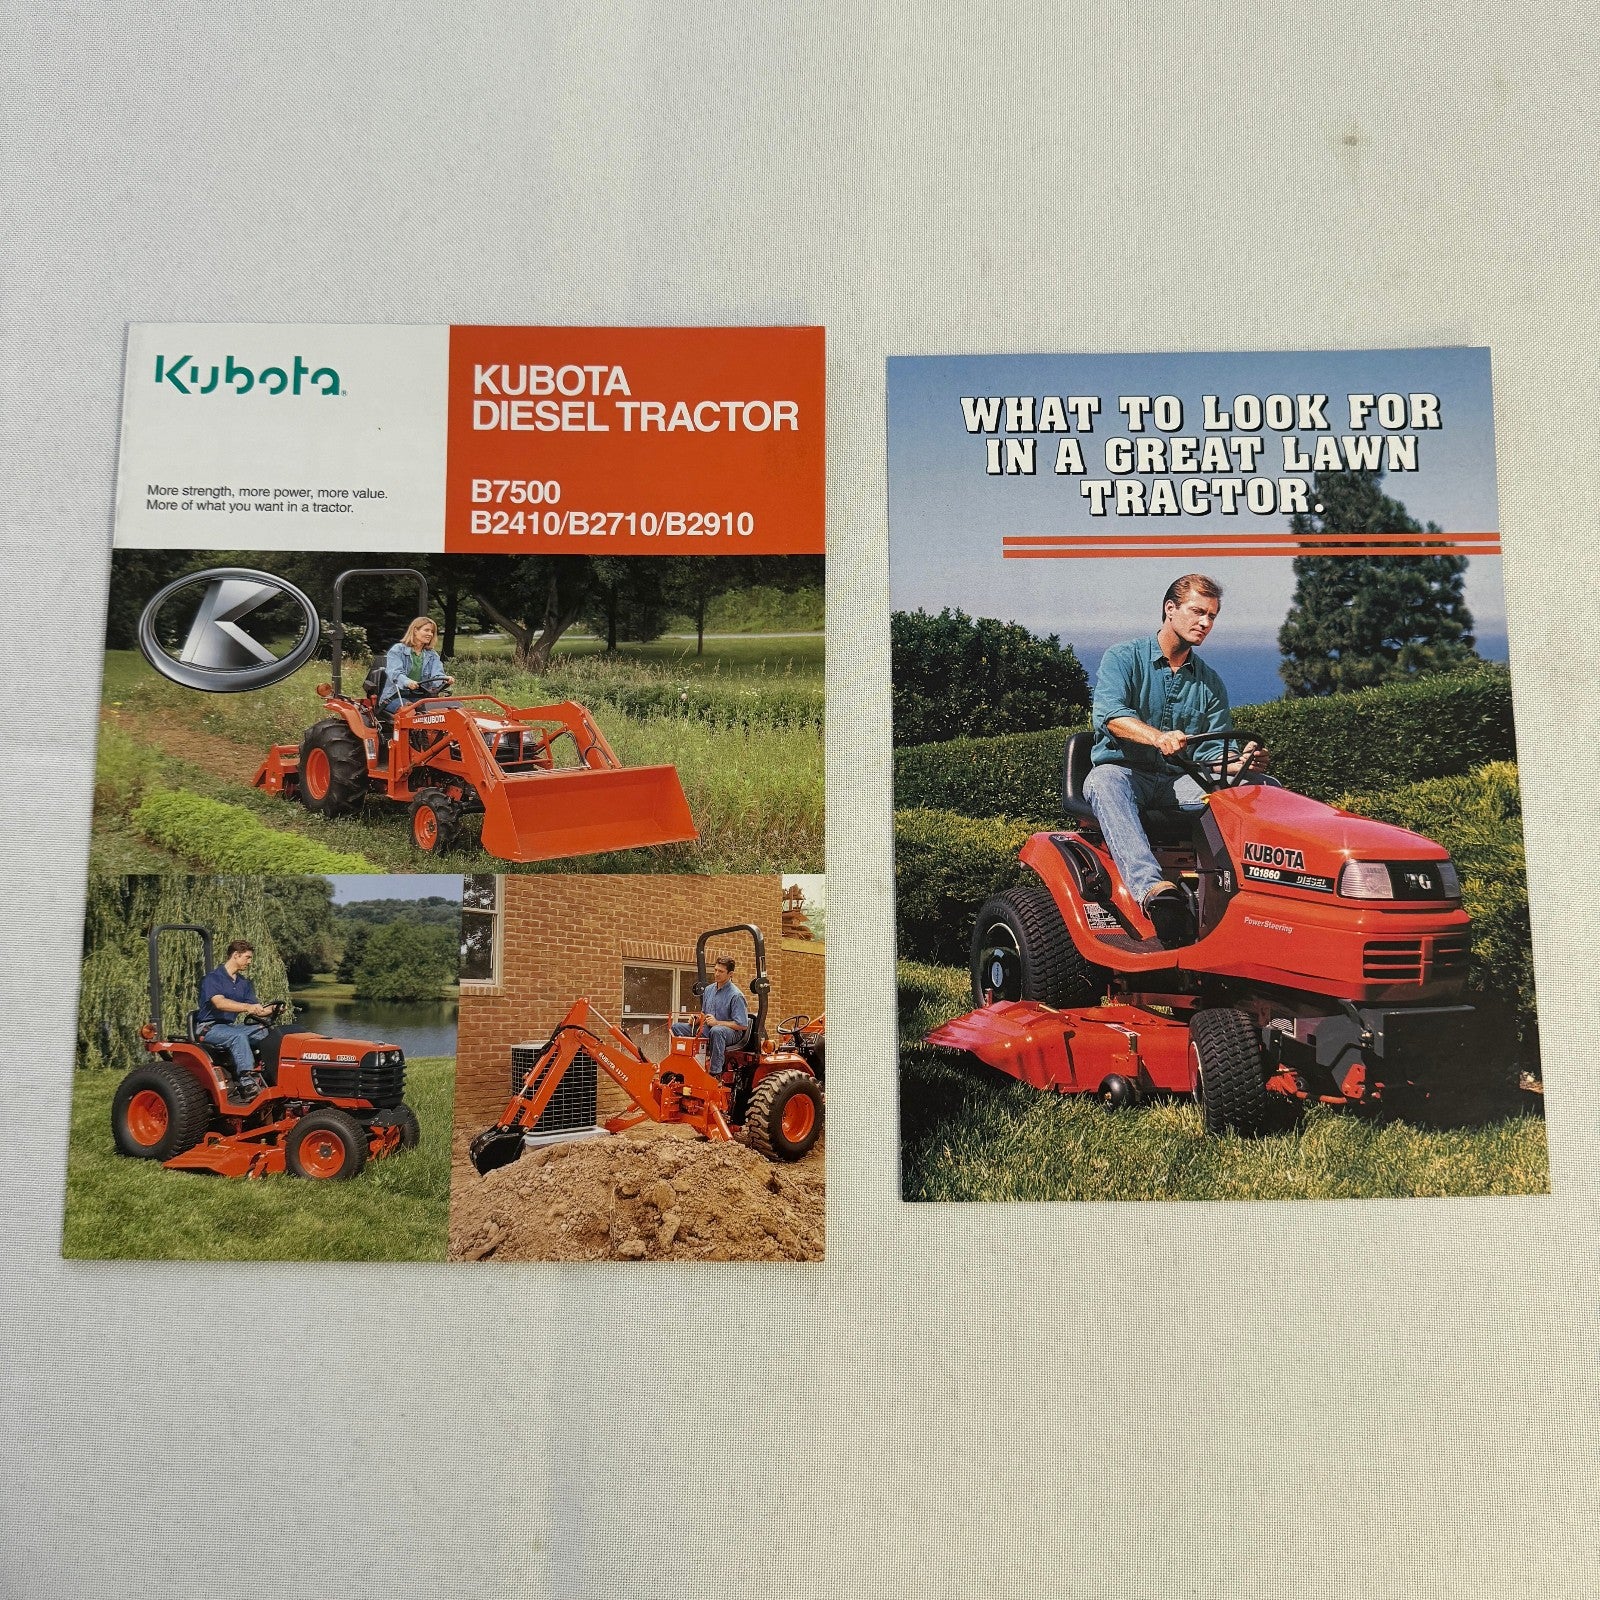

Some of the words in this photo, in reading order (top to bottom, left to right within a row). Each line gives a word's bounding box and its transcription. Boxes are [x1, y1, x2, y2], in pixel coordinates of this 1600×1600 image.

[473, 364, 632, 396] KUBOTA
[472, 400, 609, 432] DIESEL
[616, 400, 799, 432] TRACTOR
[960, 395, 1101, 433] WHAT
[1119, 394, 1184, 432] TO
[1202, 393, 1329, 431] LOOK
[1347, 392, 1443, 430] FOR
[985, 437, 1036, 475] IN
[1054, 437, 1087, 475] A
[1104, 435, 1263, 474] GREAT
[1282, 434, 1419, 472] LAWN
[147, 485, 179, 496] More
[181, 485, 235, 499] strength,
[239, 487, 271, 498] more
[273, 488, 314, 500] power,
[317, 489, 349, 499] more
[352, 488, 388, 500] value.
[471, 479, 561, 504] B7500
[1080, 477, 1325, 516] TRACTOR.
[146, 499, 178, 511] More
[181, 499, 193, 511] of
[196, 500, 226, 512] what
[229, 502, 251, 514] you
[254, 501, 284, 512] want
[287, 501, 298, 512] in
[301, 503, 309, 513] a
[313, 502, 354, 514] tractor.
[470, 510, 754, 537] B2410/B2710/B2910
[423, 714, 446, 724] KUBOTA
[1243, 842, 1305, 870] KUBOTA
[1249, 866, 1280, 880] TG1860
[1296, 875, 1327, 888] DIESEL
[1244, 916, 1293, 935] PowerSteering
[302, 1052, 331, 1061] KUBOTA
